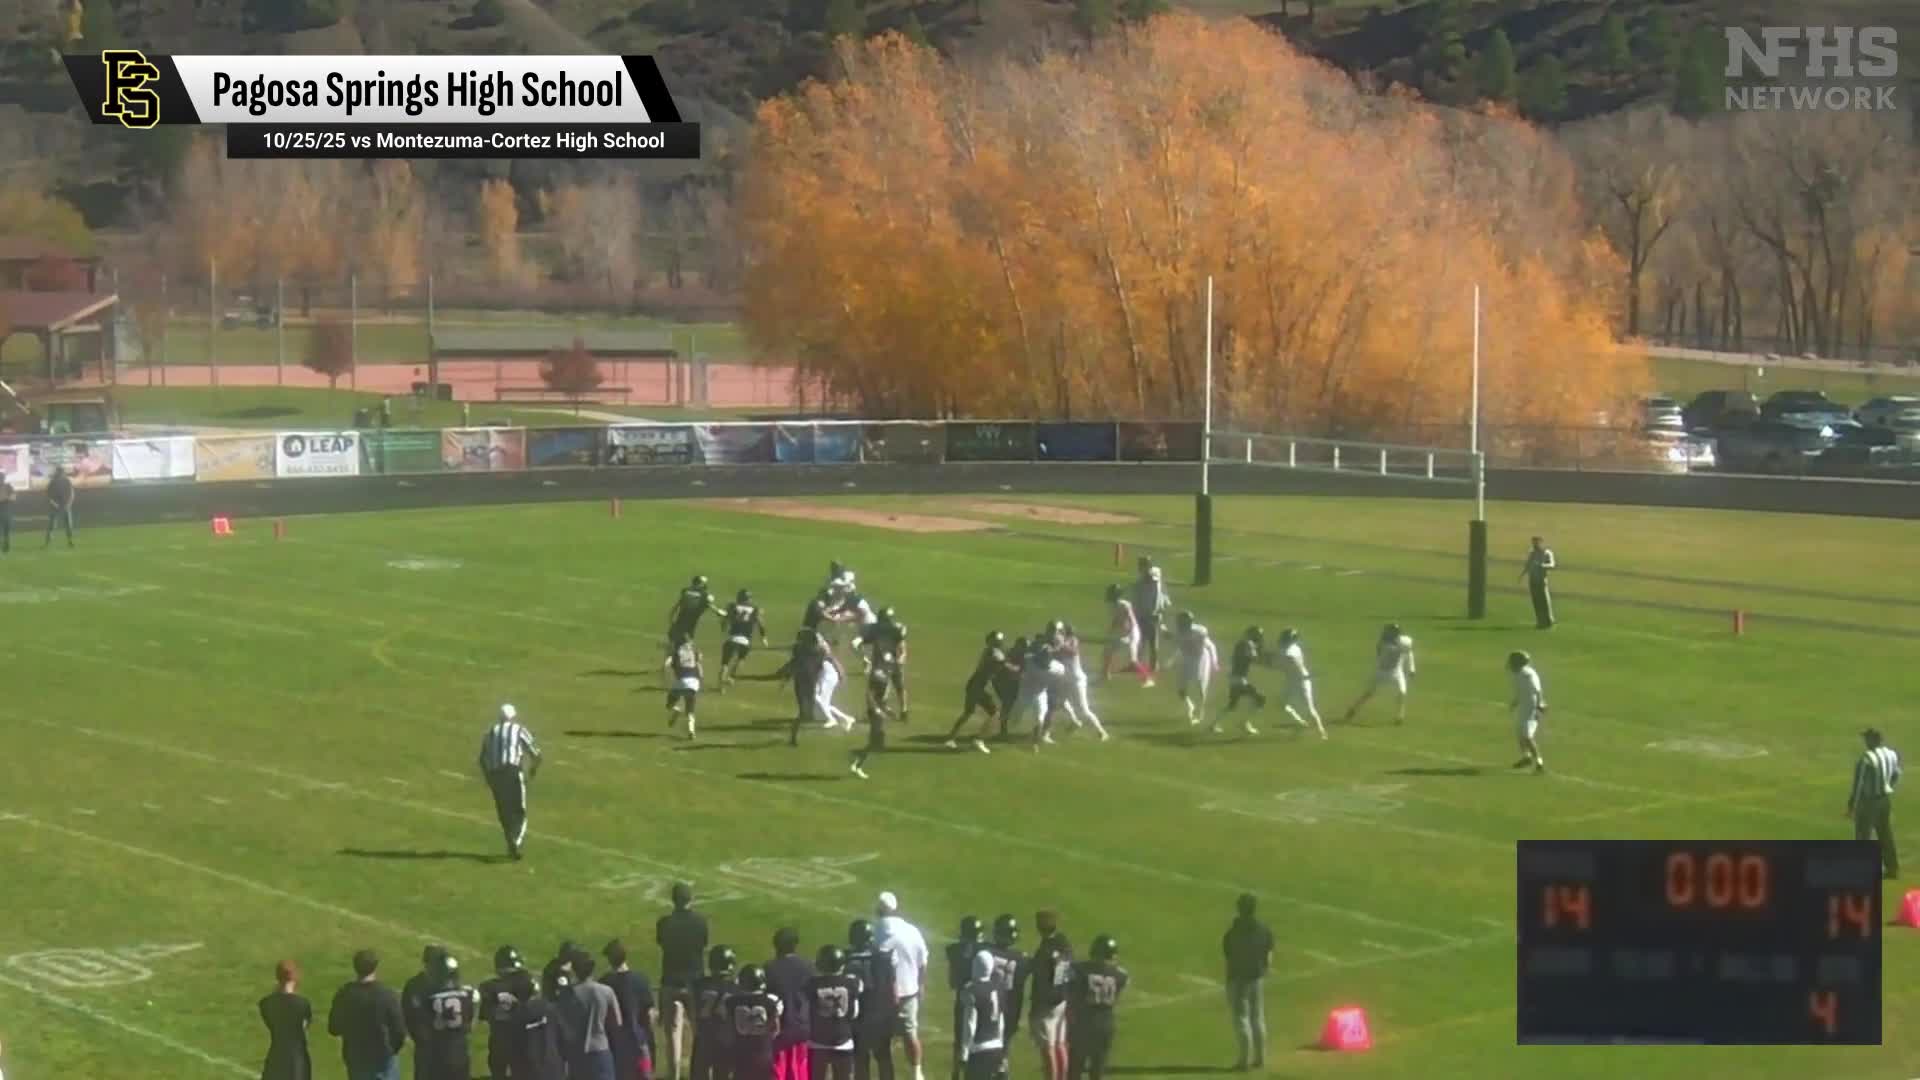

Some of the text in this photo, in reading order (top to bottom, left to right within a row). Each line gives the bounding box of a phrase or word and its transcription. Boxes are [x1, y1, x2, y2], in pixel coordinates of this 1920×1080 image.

[310, 438, 354, 453] LEAP
[1544, 885, 1590, 929] 14
[1828, 894, 1872, 939] 14
[432, 998, 462, 1030] 13
[1809, 990, 1838, 1034] 4
